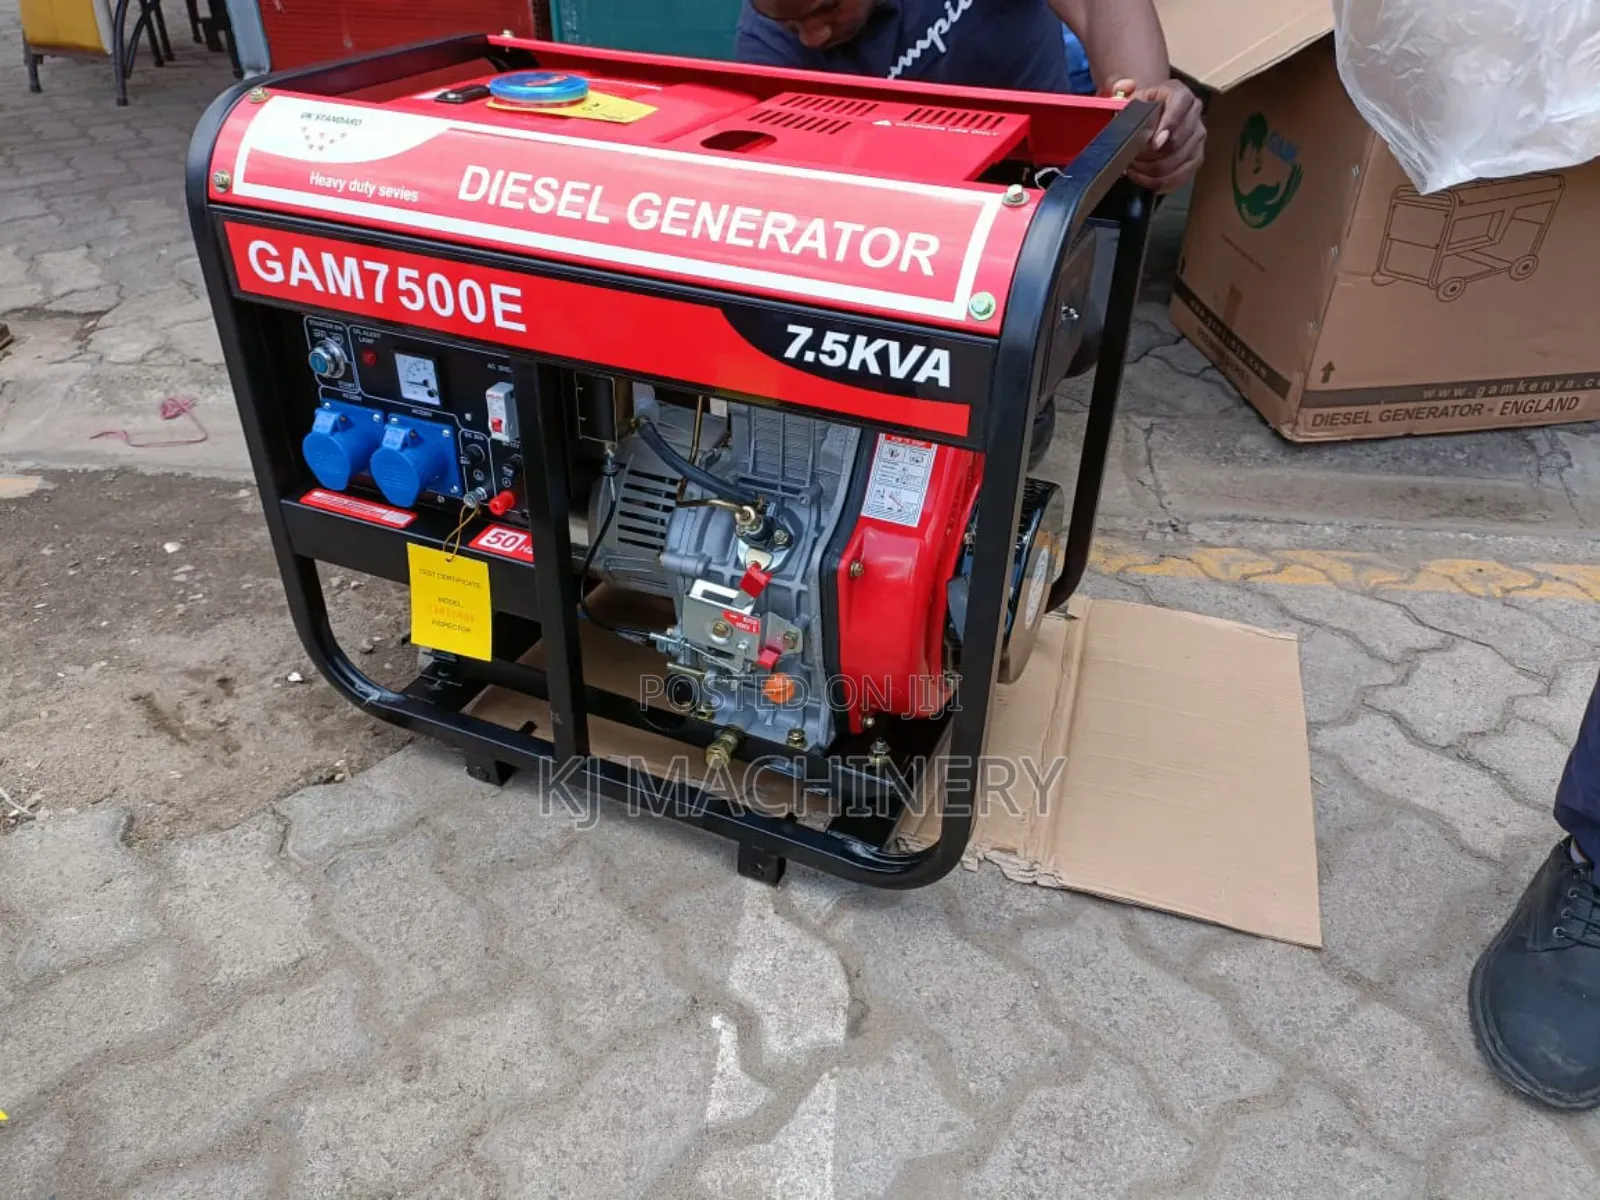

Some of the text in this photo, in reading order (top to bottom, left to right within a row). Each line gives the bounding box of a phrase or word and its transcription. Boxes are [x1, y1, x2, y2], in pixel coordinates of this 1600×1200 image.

[308, 171, 420, 203] Heavy duty sevies
[457, 163, 941, 278] DIESEL GENERATOR
[247, 239, 528, 333] GAM7500E
[783, 323, 951, 389] 7.5KVA
[1423, 376, 1600, 399] www.gamkenya.c
[1311, 410, 1373, 428] DIESEL
[1379, 403, 1484, 423] GENERATOR
[1499, 395, 1580, 416] ENGLAND
[486, 531, 519, 549] 50
[437, 572, 482, 589] CERTIFICATE
[431, 619, 472, 634] INSPECTOR
